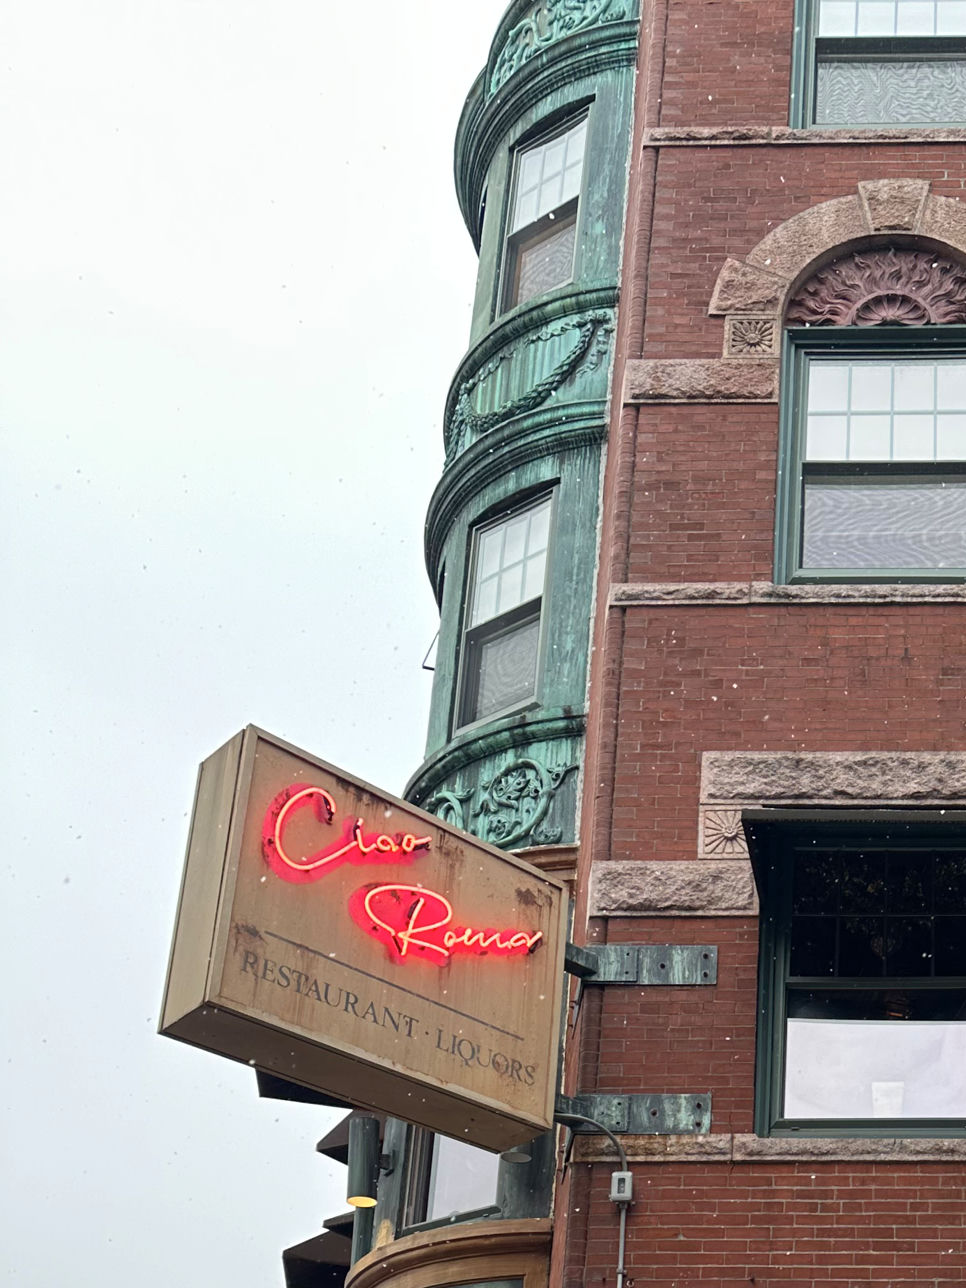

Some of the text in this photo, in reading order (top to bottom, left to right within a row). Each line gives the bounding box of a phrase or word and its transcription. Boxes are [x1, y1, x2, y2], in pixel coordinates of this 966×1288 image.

[272, 785, 433, 872] Ciao
[363, 883, 544, 957] Roma
[241, 950, 537, 1086] RESTAURANT LIQUORS
